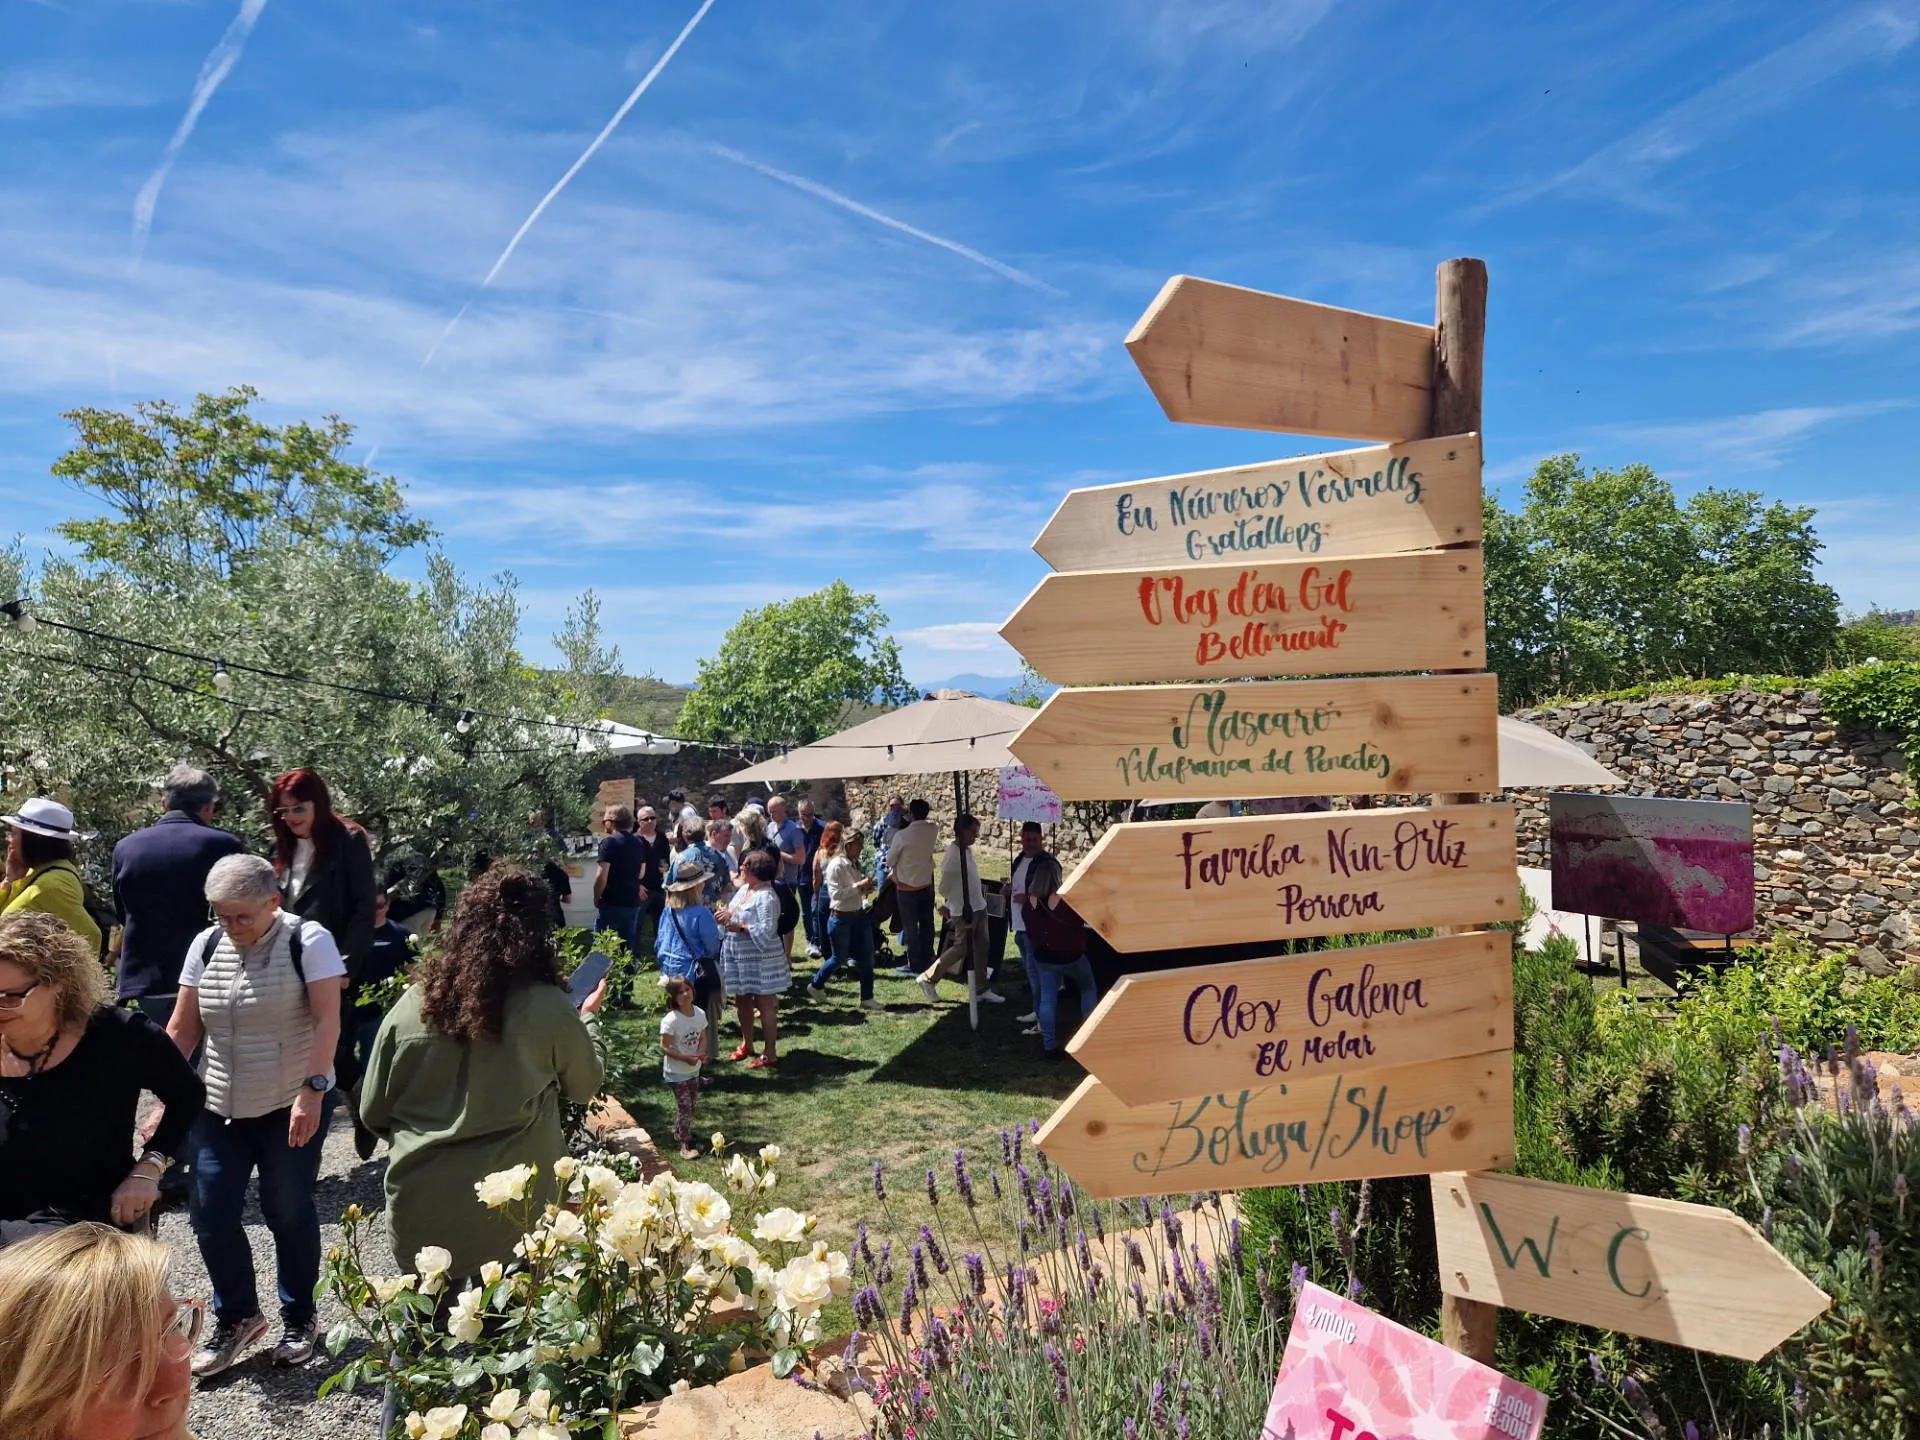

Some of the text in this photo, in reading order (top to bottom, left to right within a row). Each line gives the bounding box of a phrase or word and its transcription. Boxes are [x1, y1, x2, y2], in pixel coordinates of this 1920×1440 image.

[1299, 456, 1426, 504] Vermells
[1186, 514, 1329, 560] Gratallops
[1138, 575, 1219, 628] Mas
[1300, 567, 1355, 612] Gil
[1173, 689, 1342, 756] Mascaró
[1116, 746, 1254, 786] Vilafranca
[1261, 748, 1295, 775] del
[1327, 820, 1468, 877] Nin-Ortiz
[1277, 884, 1384, 924] Porrera
[1183, 963, 1428, 1045] Clos Galena
[1256, 1039, 1292, 1077] El
